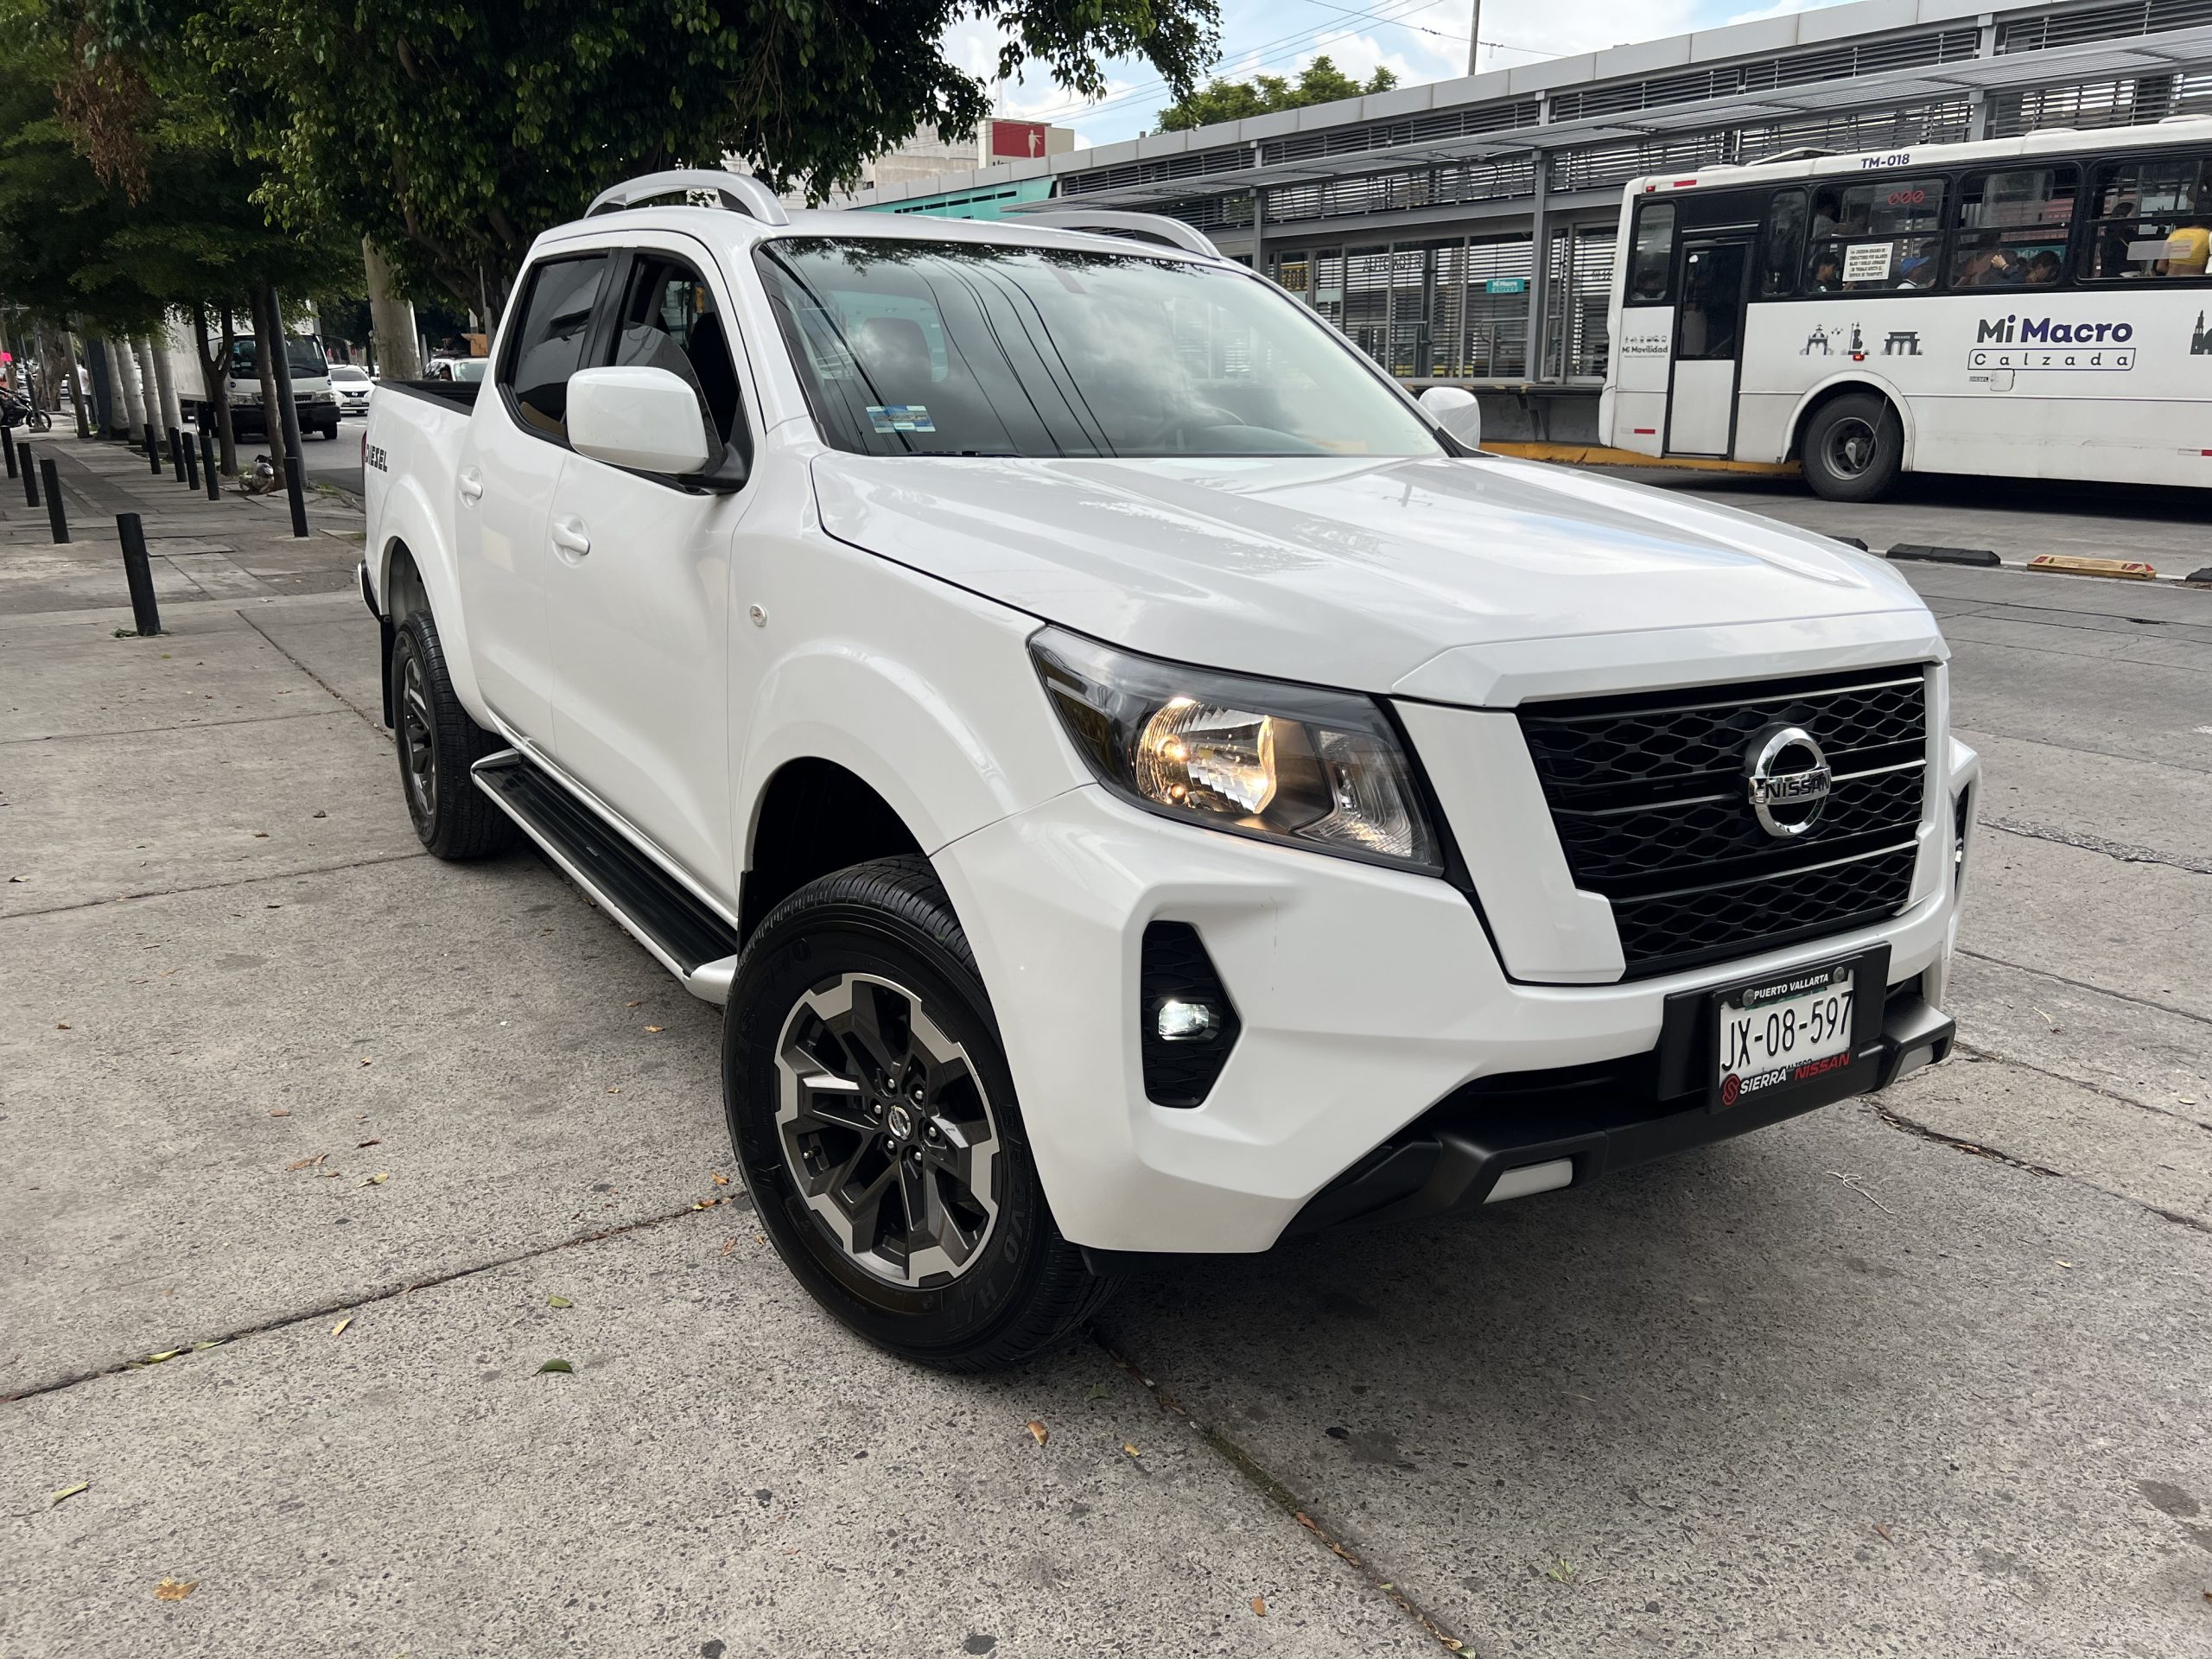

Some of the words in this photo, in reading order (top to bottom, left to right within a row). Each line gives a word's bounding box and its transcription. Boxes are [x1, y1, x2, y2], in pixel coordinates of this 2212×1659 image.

[1861, 154, 1910, 168] TM-018
[1976, 315, 2016, 343] Mi
[2020, 318, 2133, 343] Macro
[1974, 353, 2129, 365] Calzada
[365, 443, 388, 473] DIESEL
[1765, 769, 1831, 798] NISSAN
[1754, 984, 1788, 1001] PUERTO
[1789, 973, 1829, 991] VALLARTA
[1721, 990, 1853, 1071] JX-08-597
[1739, 1066, 1787, 1095] SIERRA
[1794, 1052, 1850, 1080] NISSAN
